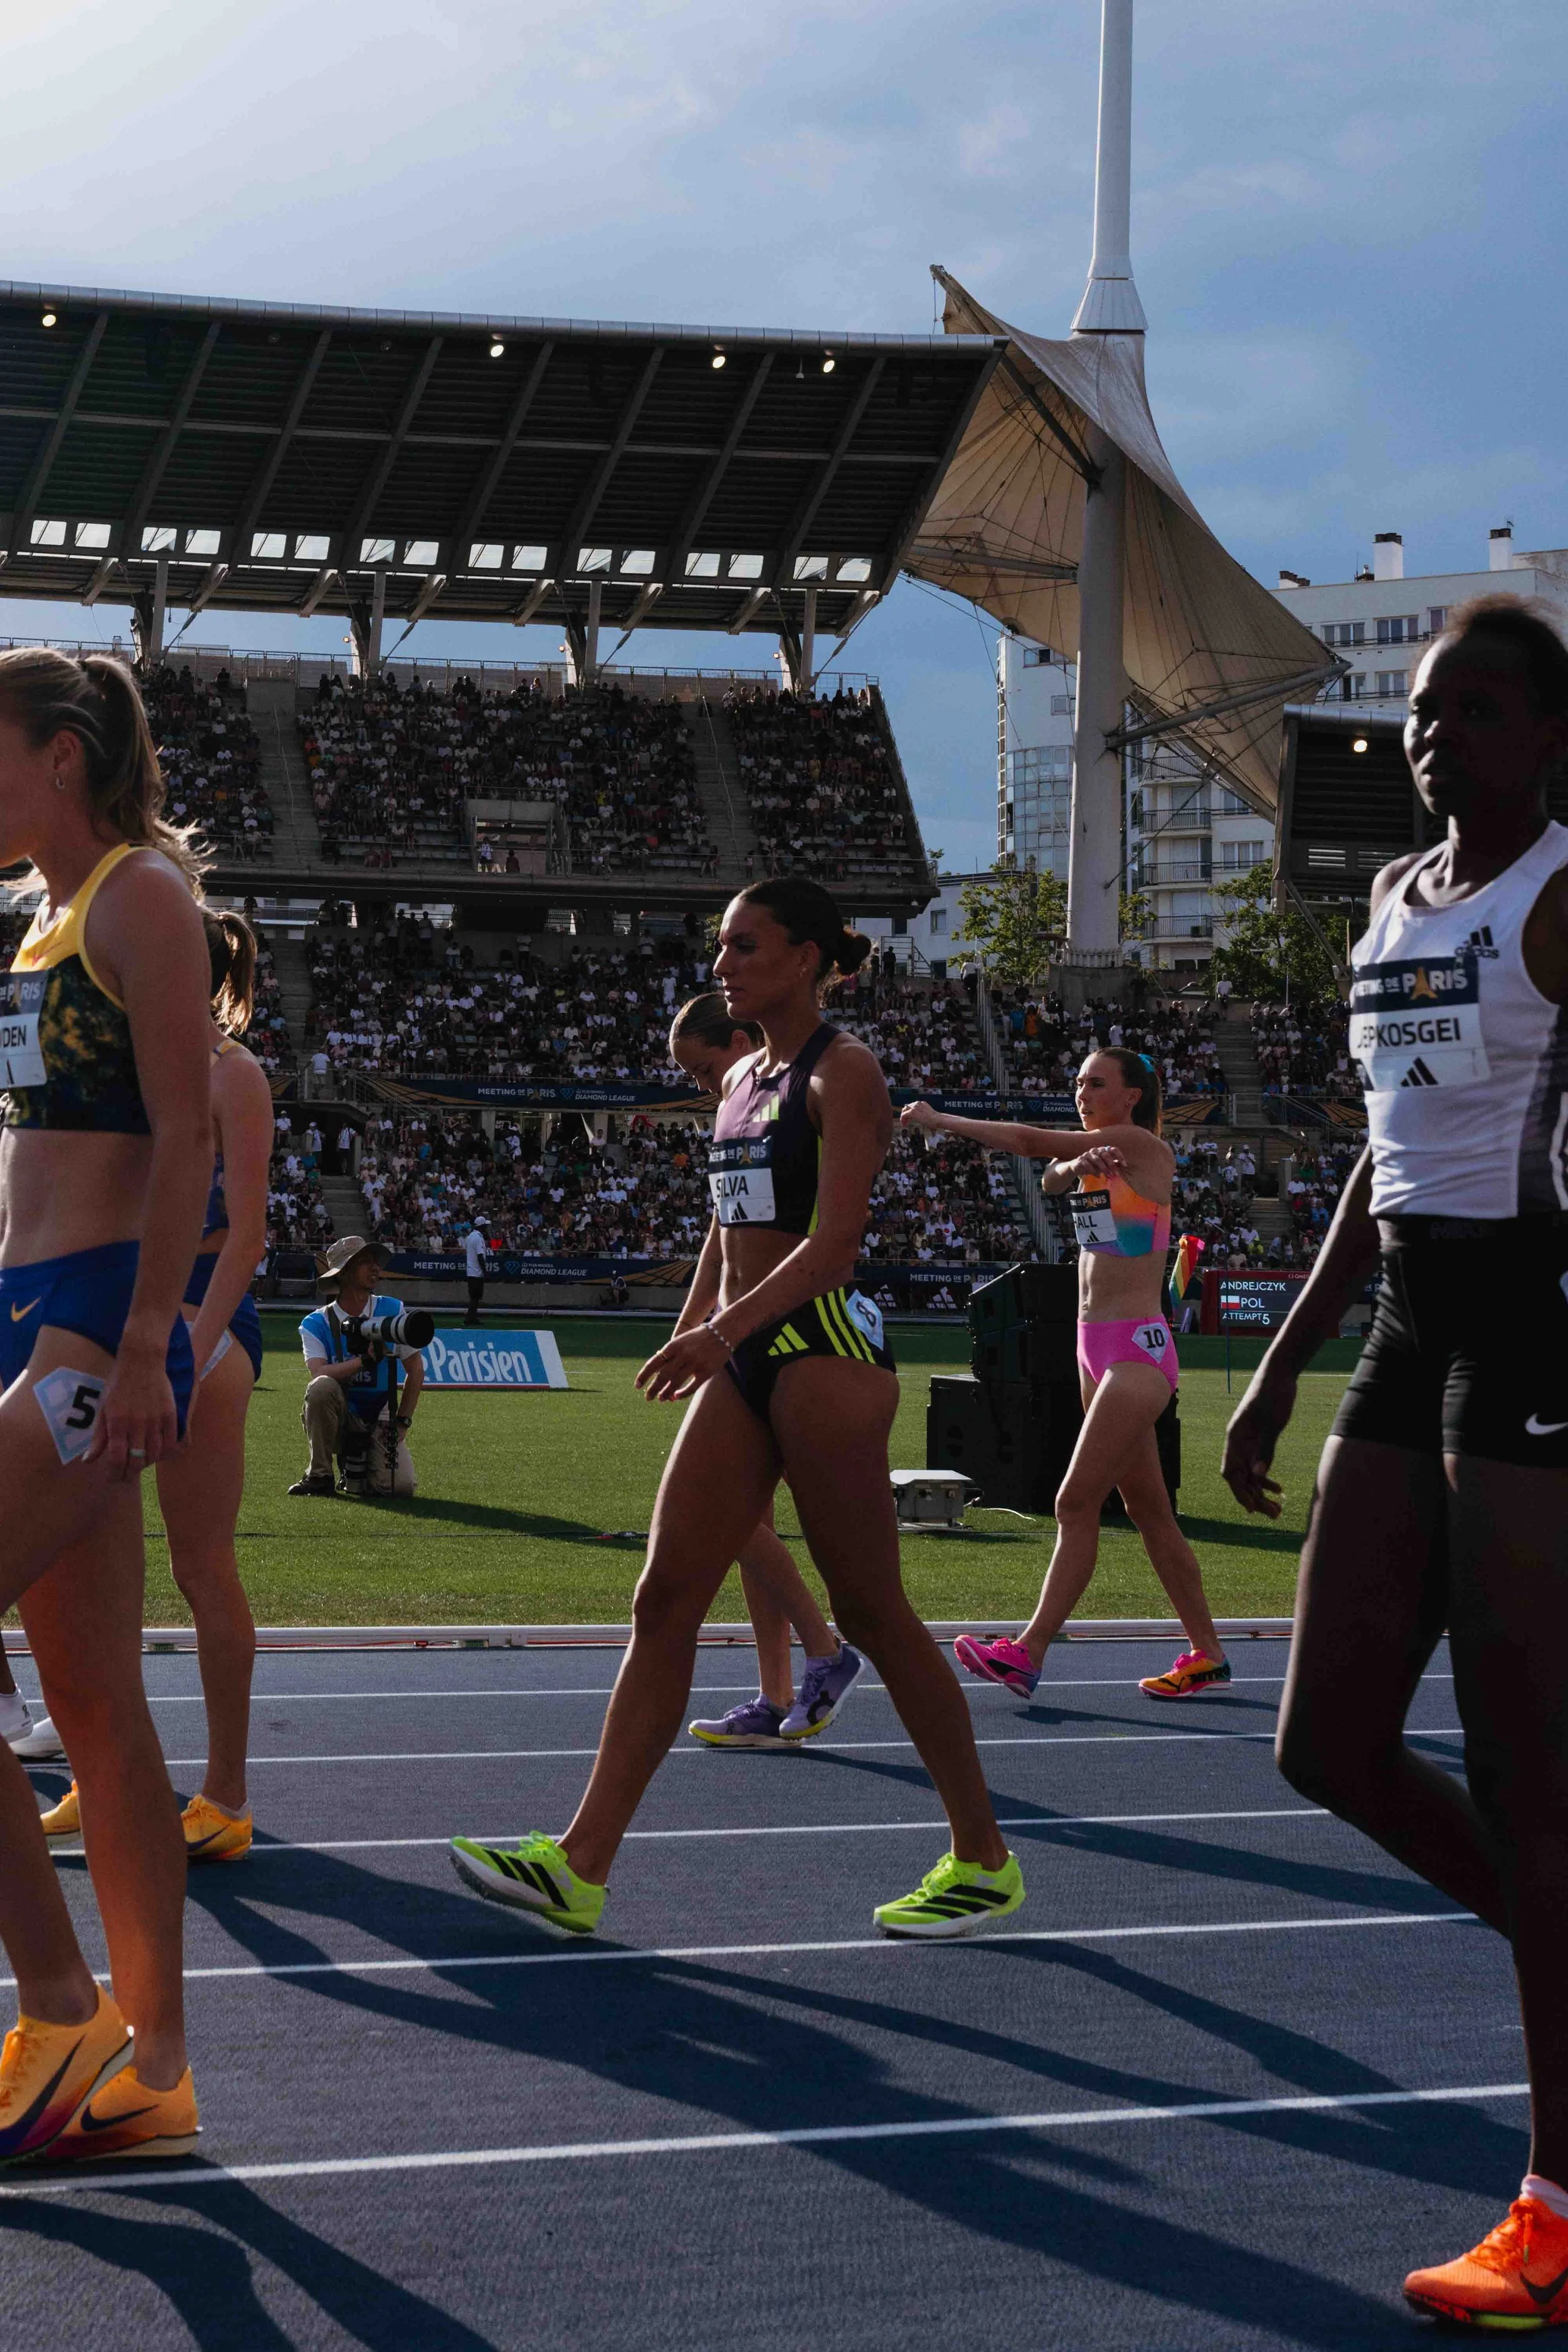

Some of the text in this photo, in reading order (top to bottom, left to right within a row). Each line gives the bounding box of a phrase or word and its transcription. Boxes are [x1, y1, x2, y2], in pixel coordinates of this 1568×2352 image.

[0, 1025, 26, 1048] DEN
[716, 1175, 749, 1199] SILVA
[414, 1261, 455, 1270] MEETING
[910, 1274, 952, 1282] MEETING
[953, 1274, 961, 1283] DE
[1220, 1281, 1286, 1291] ANDREJCZYK
[1241, 1298, 1265, 1308] POL
[856, 1301, 876, 1327] 8
[1223, 1312, 1270, 1325] ATTEMPT 5
[1143, 1328, 1165, 1348] 10
[427, 1336, 532, 1382] Parisien
[66, 1385, 102, 1430] 5
